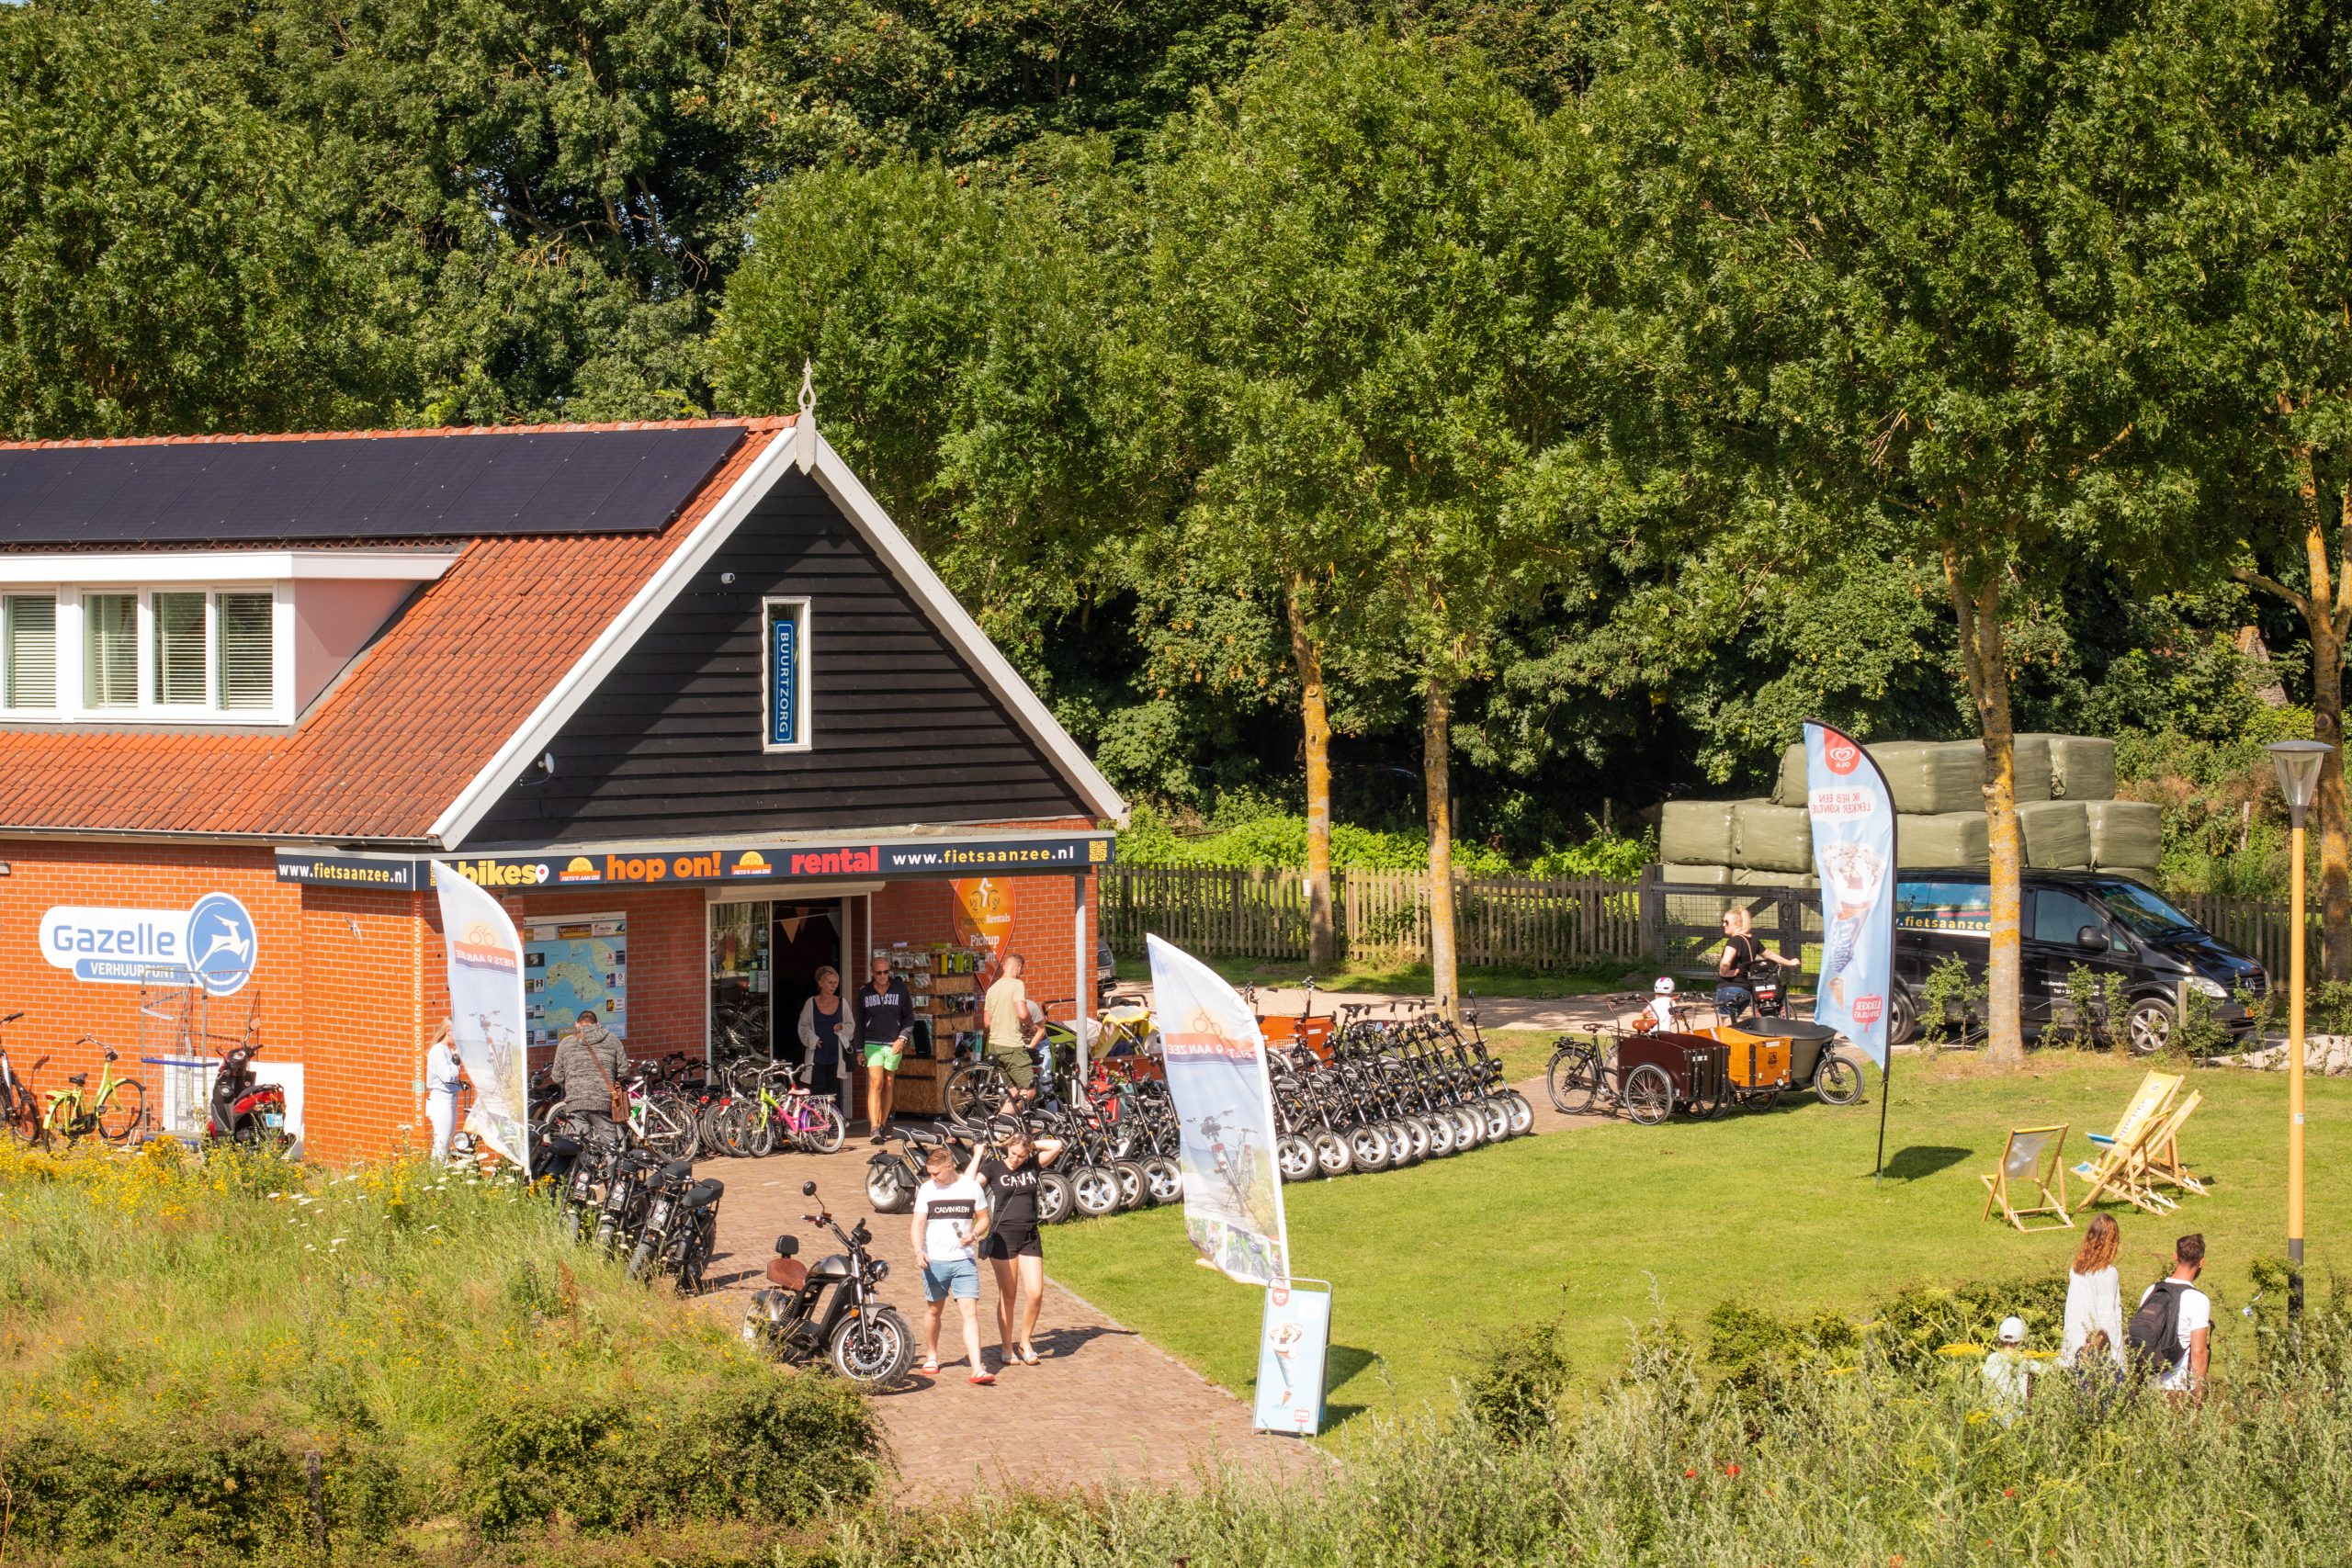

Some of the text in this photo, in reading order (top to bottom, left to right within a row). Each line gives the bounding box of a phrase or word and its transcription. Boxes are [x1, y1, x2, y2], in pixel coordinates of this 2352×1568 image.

[779, 632, 789, 733] BUURTZORG
[791, 845, 879, 874] rental
[892, 845, 1074, 866] www.fietsaanzee.nl
[278, 863, 407, 883] www.fietsaanzee.nl
[458, 860, 537, 886] bikes
[606, 852, 722, 883] hop on!
[986, 913, 1011, 924] Rentals
[53, 923, 175, 956] Gazelle
[970, 933, 1000, 949] Pickup
[89, 961, 175, 979] VERHUURPUNT
[414, 1054, 423, 1111] WEBWINKEL
[415, 1113, 423, 1126] DE
